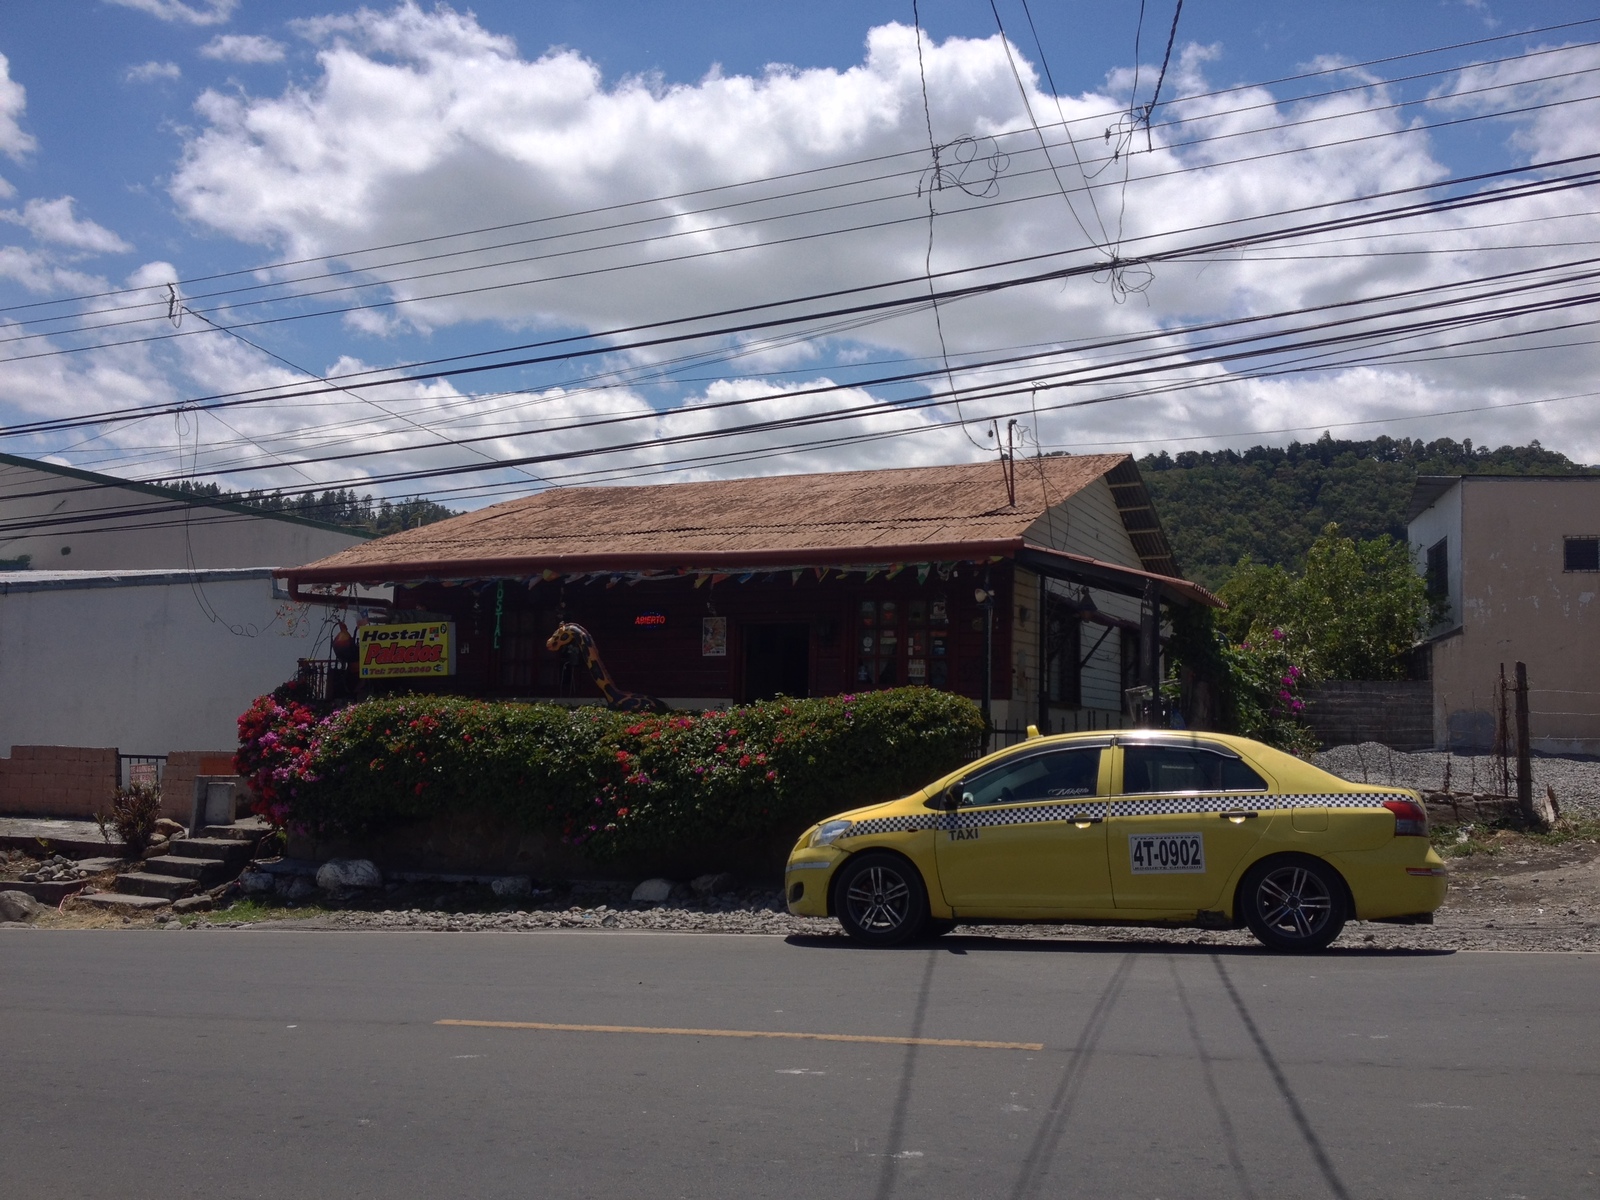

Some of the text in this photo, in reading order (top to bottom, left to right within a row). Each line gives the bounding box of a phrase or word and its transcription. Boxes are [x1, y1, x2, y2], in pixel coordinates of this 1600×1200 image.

[634, 615, 666, 625] ABIERTO
[362, 628, 428, 641] Hostal
[369, 667, 385, 675] Tel:
[948, 828, 979, 841] TAXI
[1133, 839, 1201, 866] 4T-0902
